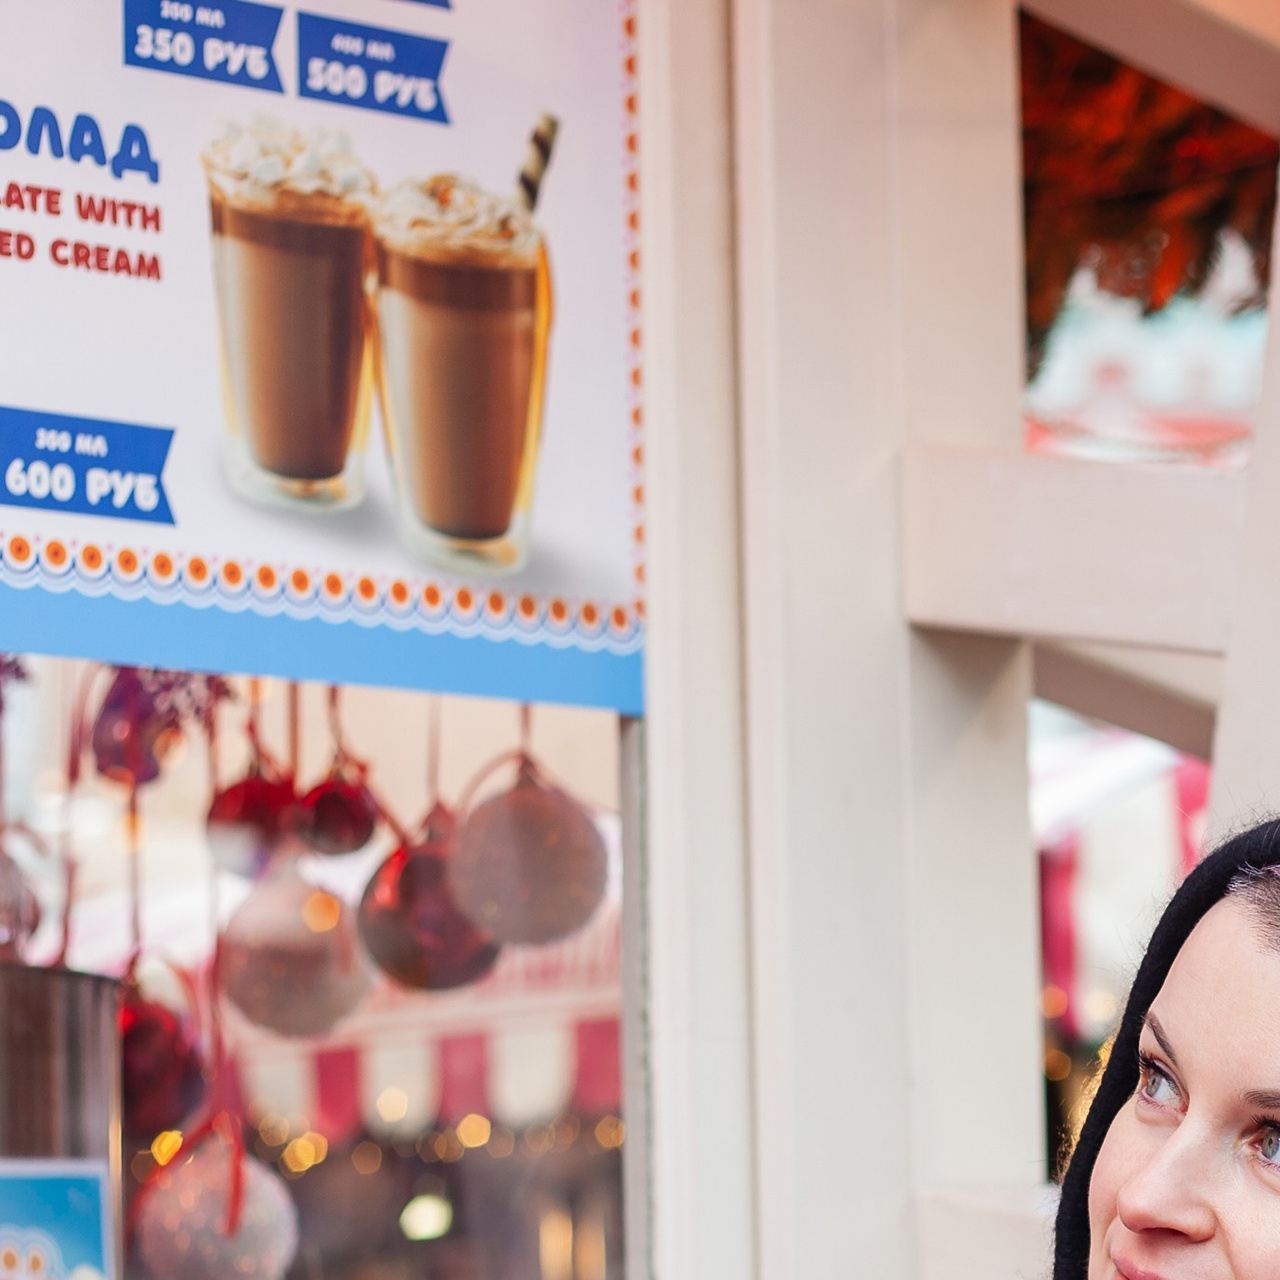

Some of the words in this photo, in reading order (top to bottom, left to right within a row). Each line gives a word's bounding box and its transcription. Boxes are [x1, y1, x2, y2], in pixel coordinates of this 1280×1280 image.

[134, 24, 195, 66] 350
[203, 37, 270, 80] РУБ
[306, 56, 368, 99] 500
[373, 69, 438, 112] РУБ
[0, 182, 61, 216] ATE
[76, 193, 160, 232] WITH
[0, 231, 35, 260] ED
[51, 240, 161, 281] CREAM
[5, 457, 76, 502] 600
[86, 467, 160, 512] РУБ
